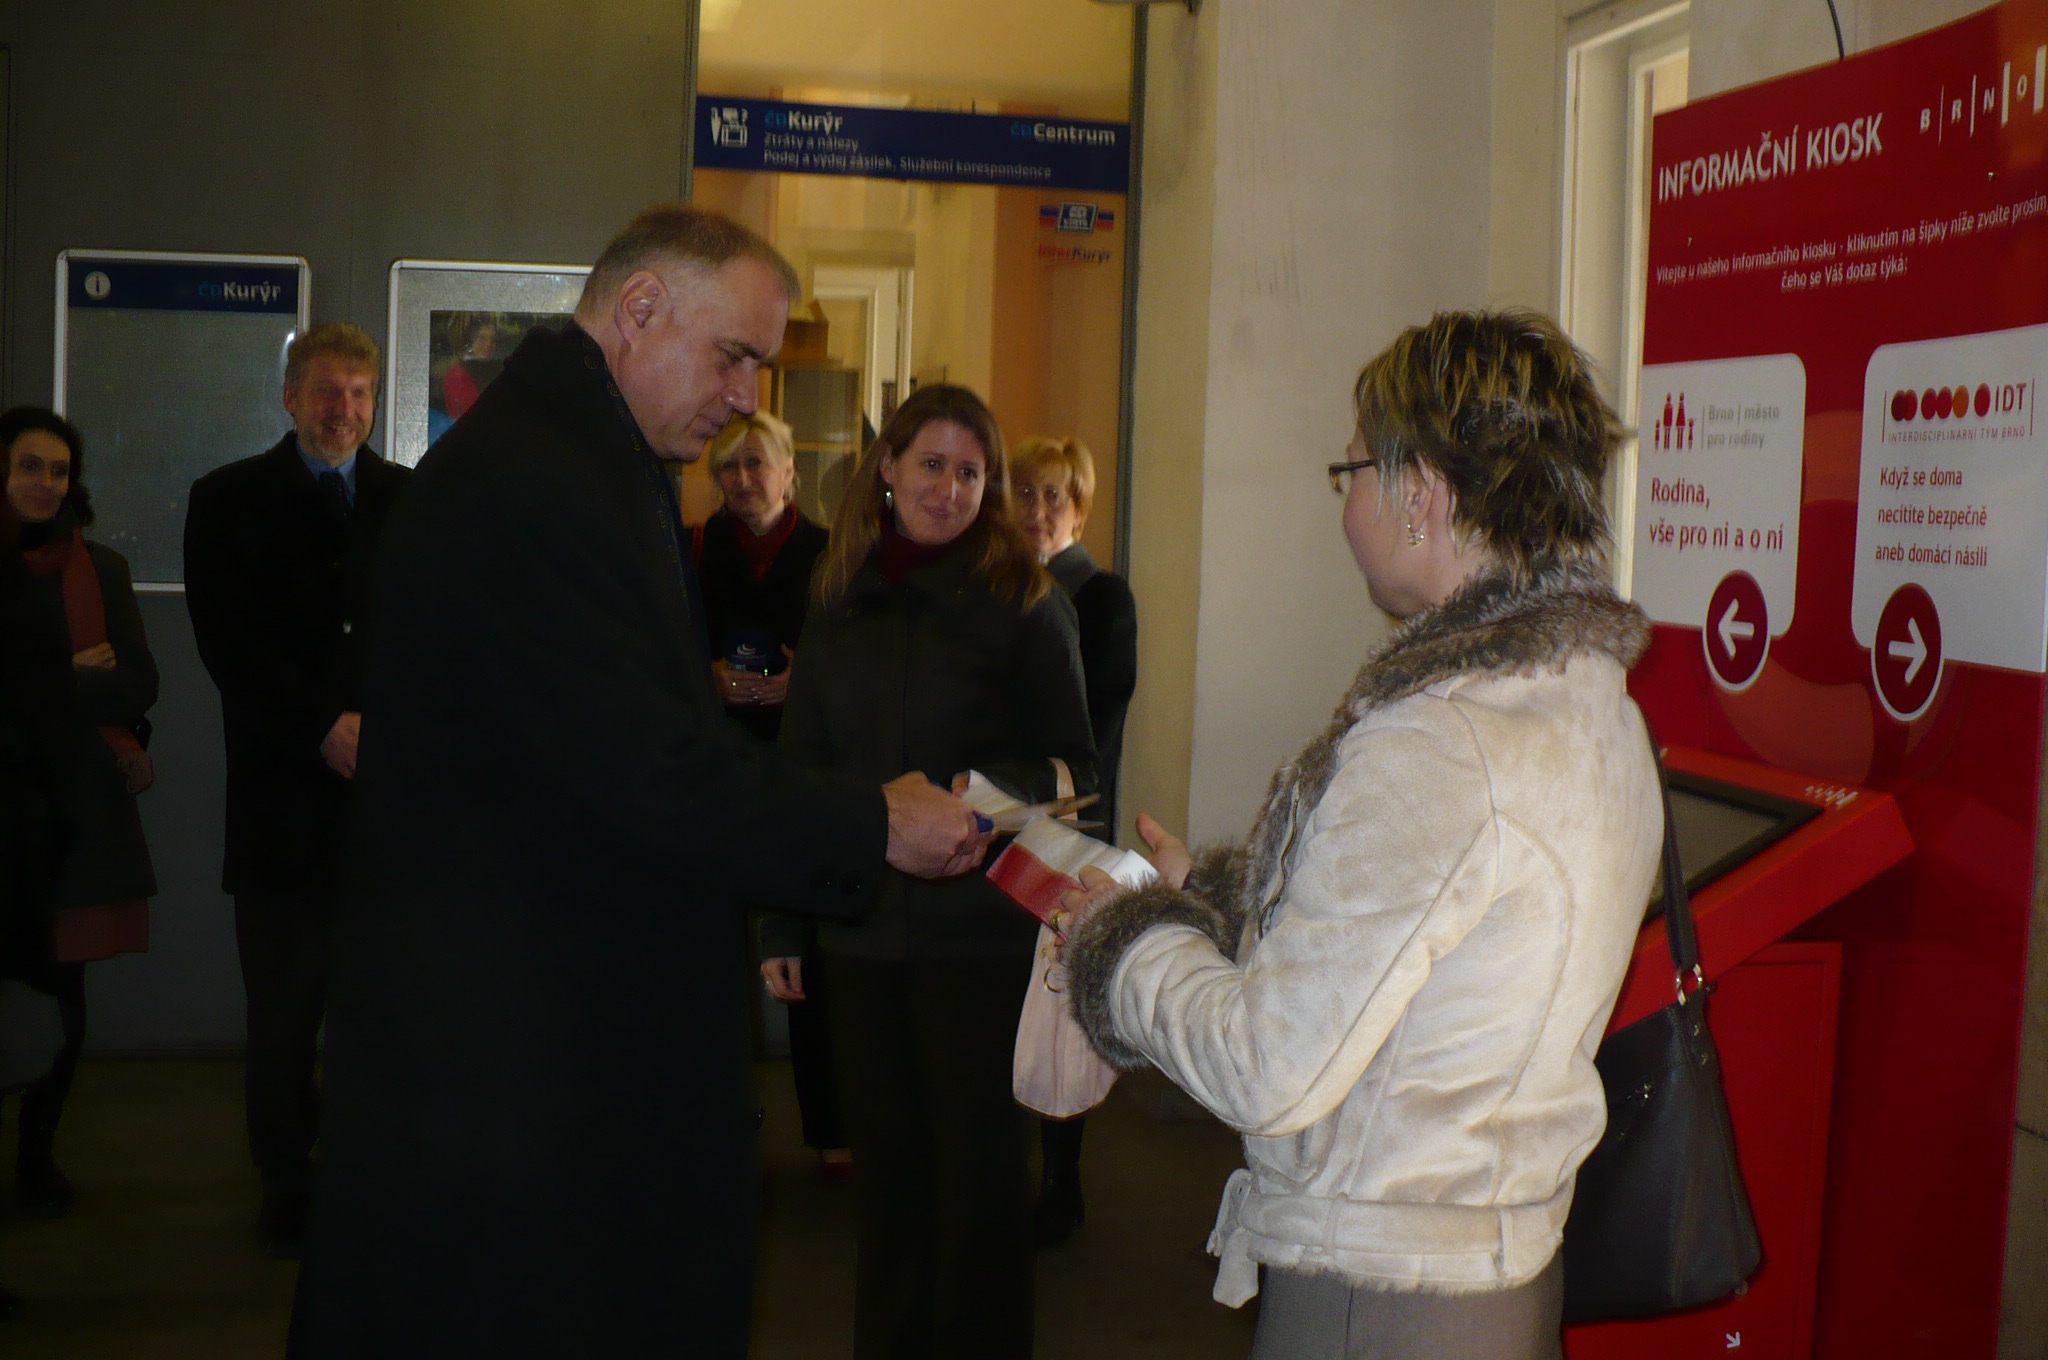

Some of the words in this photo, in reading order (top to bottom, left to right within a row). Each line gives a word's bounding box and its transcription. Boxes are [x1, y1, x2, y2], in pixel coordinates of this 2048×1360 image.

[807, 136, 815, 150] a
[802, 152, 810, 167] a
[1658, 124, 1799, 203] INFORMAČNÍ
[1806, 112, 1884, 171] KIOSK
[1656, 265, 1687, 287] Vítejte
[1689, 265, 1695, 279] u
[1697, 257, 1730, 280] našeho
[1732, 244, 1800, 273] informačního
[1802, 238, 1837, 264] kiosku
[1847, 227, 1899, 255] kliknutím
[1902, 227, 1916, 246] na
[1919, 218, 1948, 245] šipky
[1950, 210, 1975, 236] níže
[1977, 203, 2011, 231] zvolte
[1781, 269, 1808, 293] čeho
[1809, 271, 1822, 288] se
[1825, 261, 1844, 286] Váš
[1847, 257, 1878, 283] dotaz
[1995, 382, 2027, 412] IDT
[1708, 404, 1734, 421] Brno
[1744, 404, 1780, 419] město
[1707, 432, 1726, 450] pro
[1728, 430, 1765, 450] rodiny
[2001, 425, 2026, 438] BRNO
[1880, 466, 1909, 491] Když
[1913, 470, 1926, 486] se
[1929, 466, 1962, 486] doma
[1651, 477, 1710, 512] Rodina,
[1878, 504, 1925, 524] necítíte
[1927, 504, 1987, 531] bezpečně
[1650, 517, 1675, 544] vše
[1680, 524, 1708, 552] pro
[1735, 527, 1744, 548] a
[1750, 528, 1761, 549] o
[1767, 522, 1784, 551] ní
[1875, 542, 1904, 561] aneb
[1908, 543, 1952, 564] domácí
[1955, 545, 1988, 567] násilí
